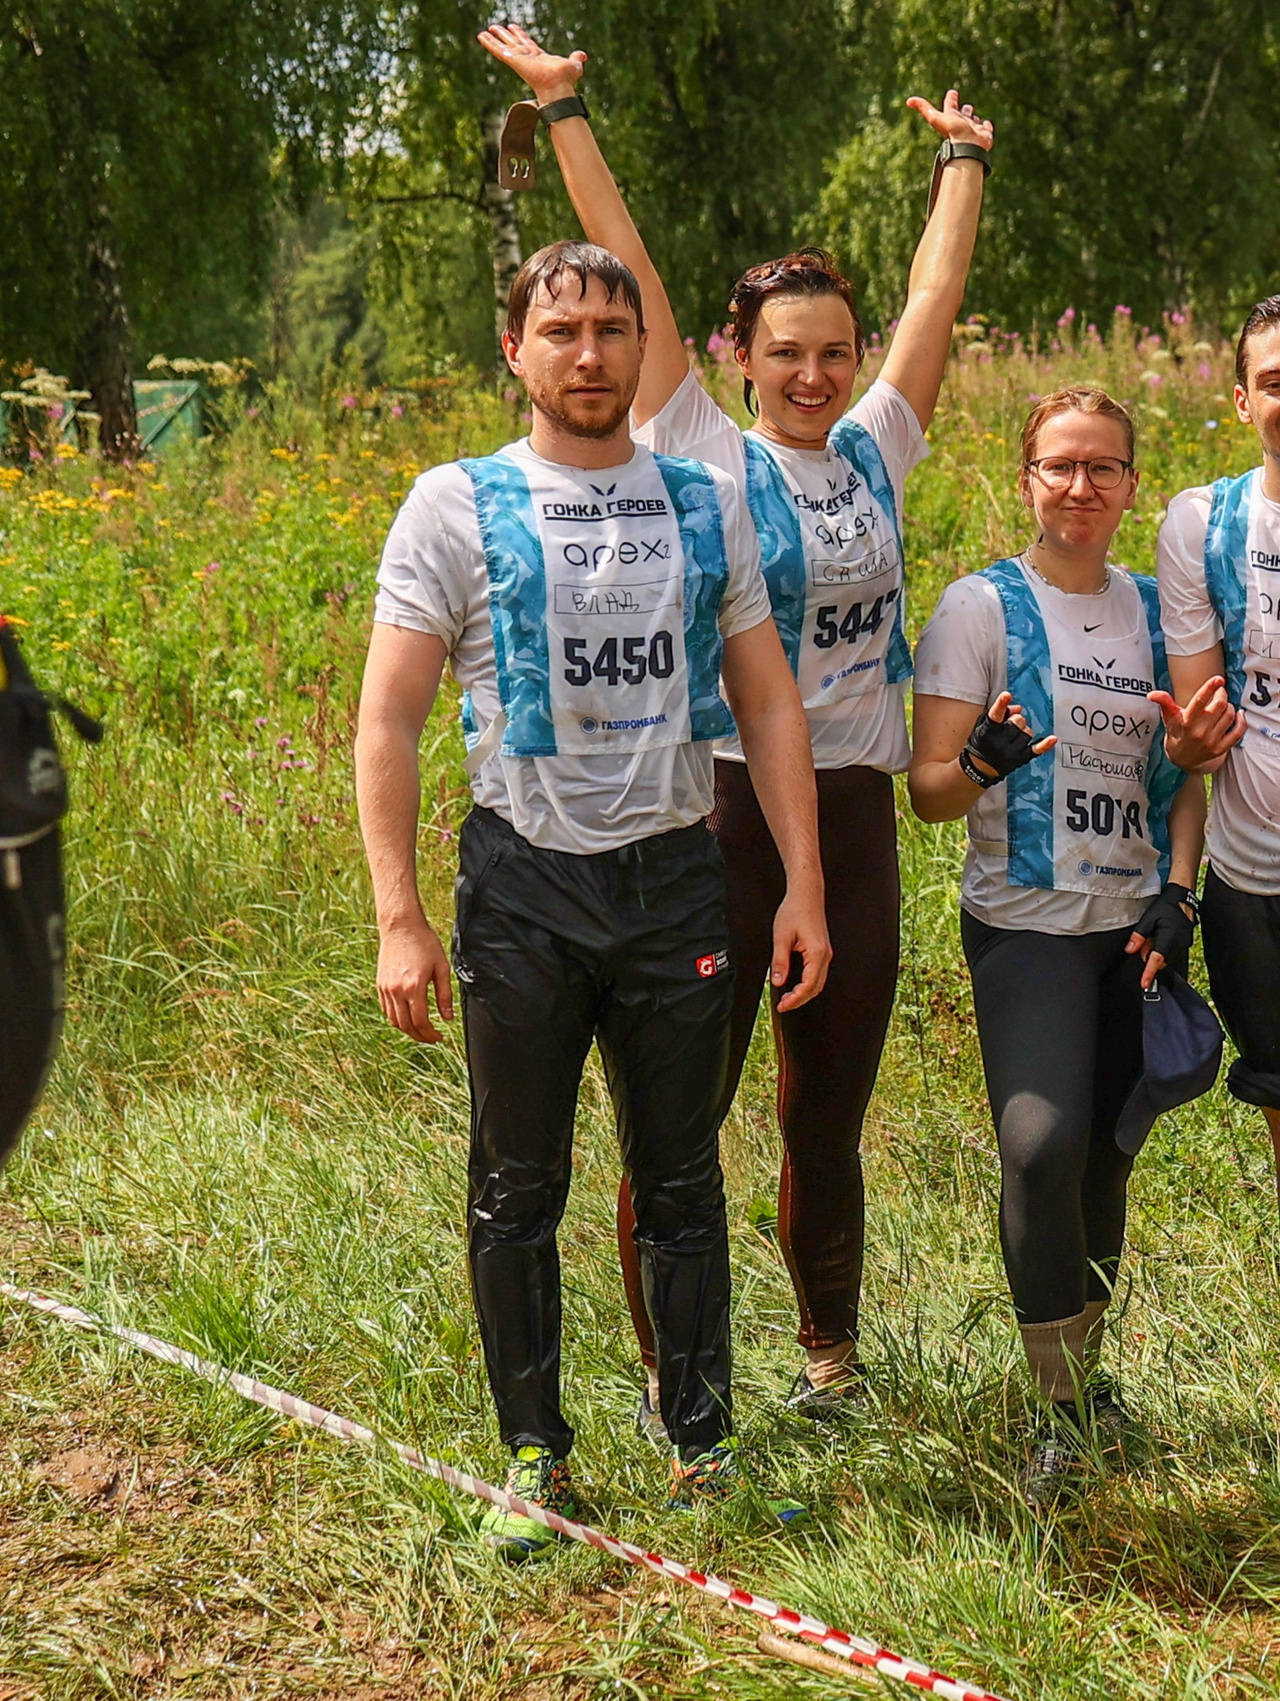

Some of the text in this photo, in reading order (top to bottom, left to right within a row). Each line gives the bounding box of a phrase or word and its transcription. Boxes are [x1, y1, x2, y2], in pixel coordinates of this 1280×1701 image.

[543, 499, 667, 517] ГОНКА ГЕРОЕВ
[572, 589, 640, 614] ВЛАД
[563, 630, 675, 686] 5450
[1058, 664, 1153, 693] ГОНКА ГЕРОЕВ
[602, 714, 667, 730] ГАЗПРОМБАНК
[1095, 865, 1143, 877] ГАЗПРОМБАНК
